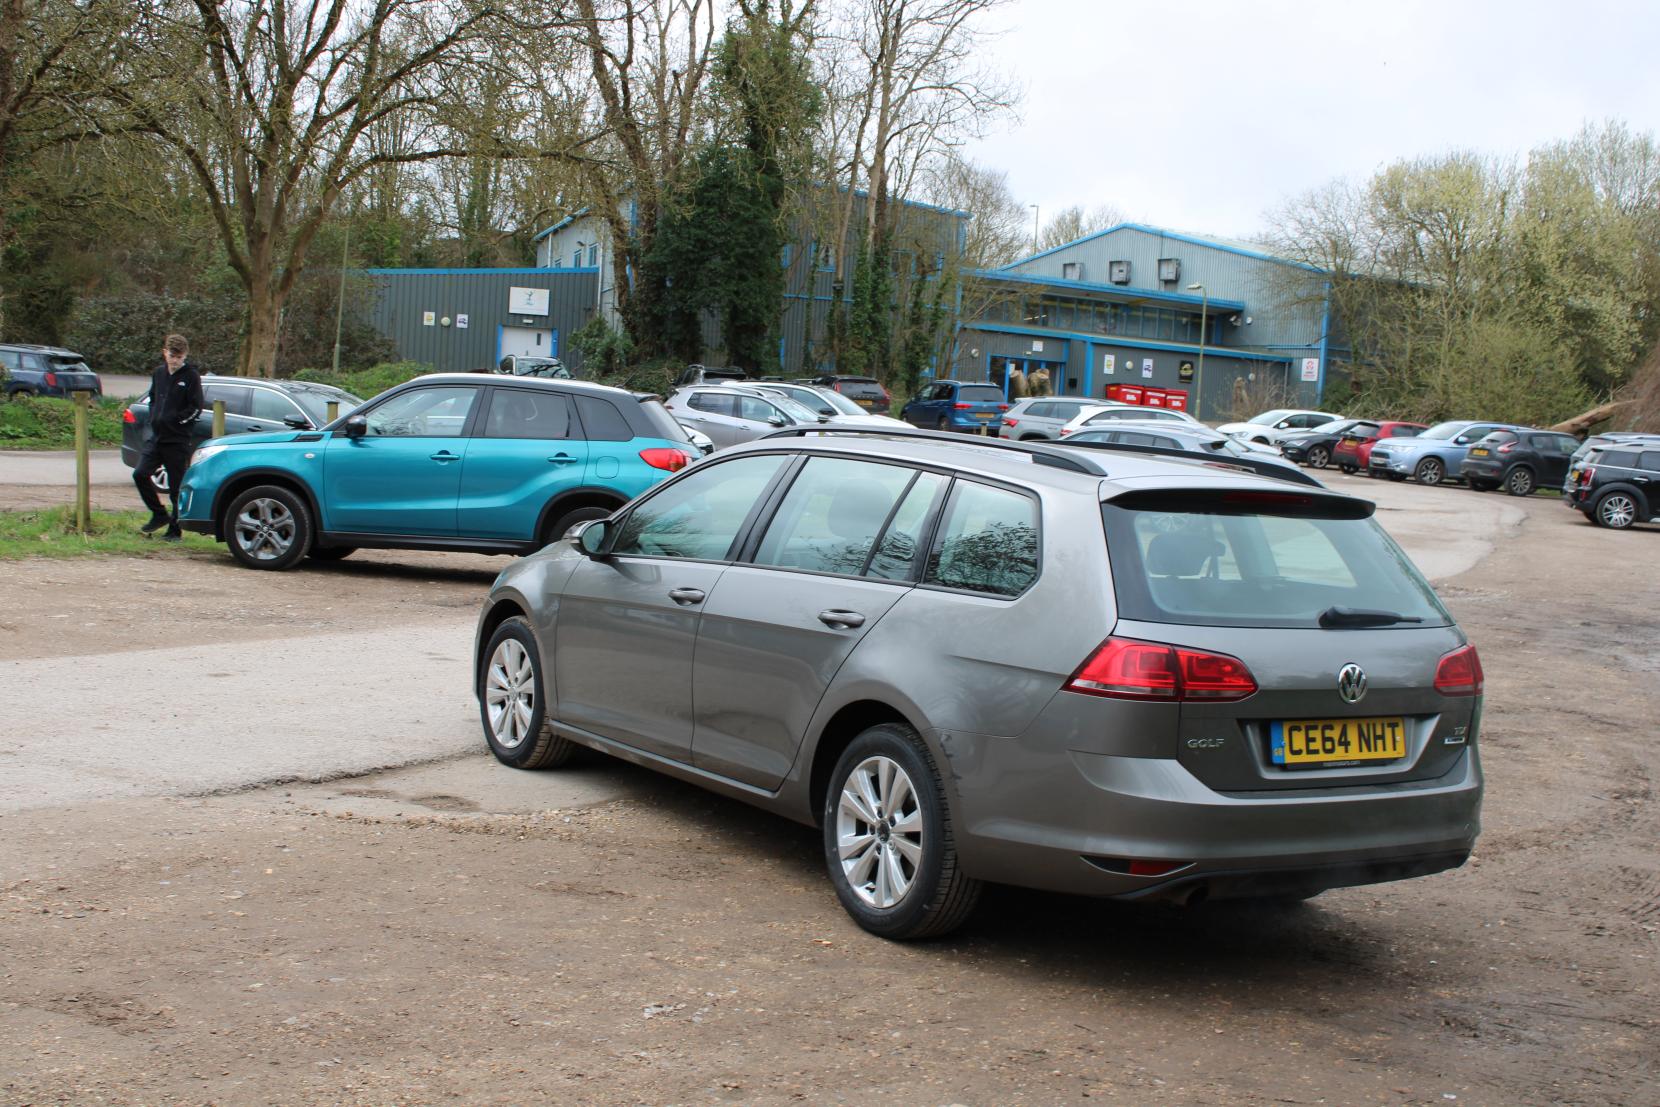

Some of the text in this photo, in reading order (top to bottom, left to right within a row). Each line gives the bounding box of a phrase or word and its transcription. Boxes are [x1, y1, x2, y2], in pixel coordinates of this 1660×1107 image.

[1338, 662, 1367, 704] VW
[1187, 738, 1225, 748] GOLF
[1288, 722, 1399, 756] CE64 NHT
